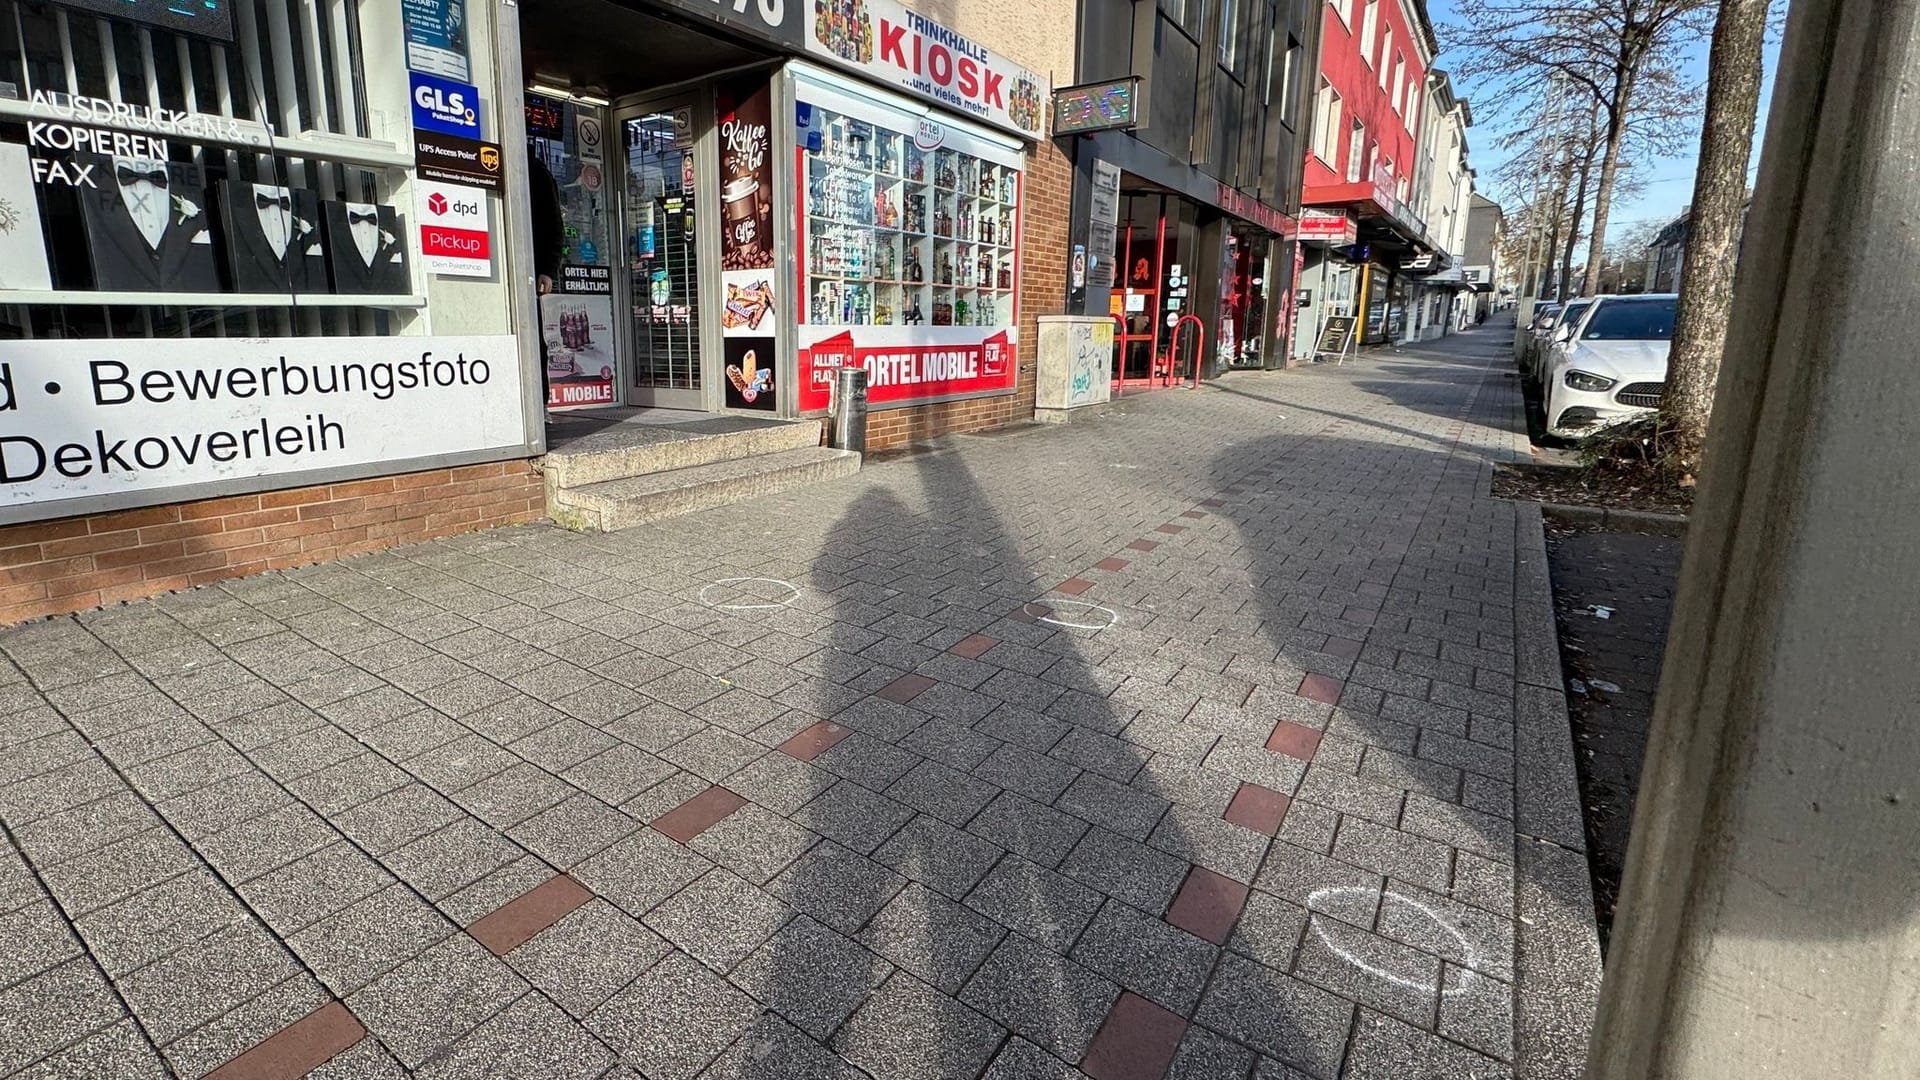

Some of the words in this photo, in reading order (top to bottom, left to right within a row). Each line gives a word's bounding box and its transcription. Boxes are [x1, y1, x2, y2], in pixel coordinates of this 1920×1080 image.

[905, 10, 987, 65] TRINKHALLE
[880, 18, 1003, 110] KIOSK
[415, 85, 464, 115] GLS
[934, 86, 962, 105] vieles
[964, 101, 989, 117] mehr!
[28, 89, 224, 138] AUSDRUCKEN
[227, 119, 246, 142] &
[432, 112, 465, 125] PaketShop
[920, 121, 939, 135] ortel
[26, 121, 169, 162] KOPIEREN
[721, 119, 766, 153] Kaffee
[920, 131, 939, 141] MOBILE
[419, 143, 434, 153] UPS
[435, 146, 457, 157] Access
[457, 150, 477, 160] Point
[482, 154, 498, 167] ups
[32, 158, 97, 188] FAX
[453, 200, 477, 216] dpd
[430, 233, 480, 253] Pickup
[565, 267, 589, 277] ORTEL
[590, 269, 608, 278] HIER
[565, 279, 609, 291] ERHÄLTLICH
[813, 353, 844, 367] ALLNET
[863, 353, 921, 387] ORTEL
[923, 352, 978, 382] MOBILE
[89, 352, 491, 405] Bewerbungsfoto
[563, 384, 611, 402] MOBILE
[0, 414, 346, 484] Dekoverleih
